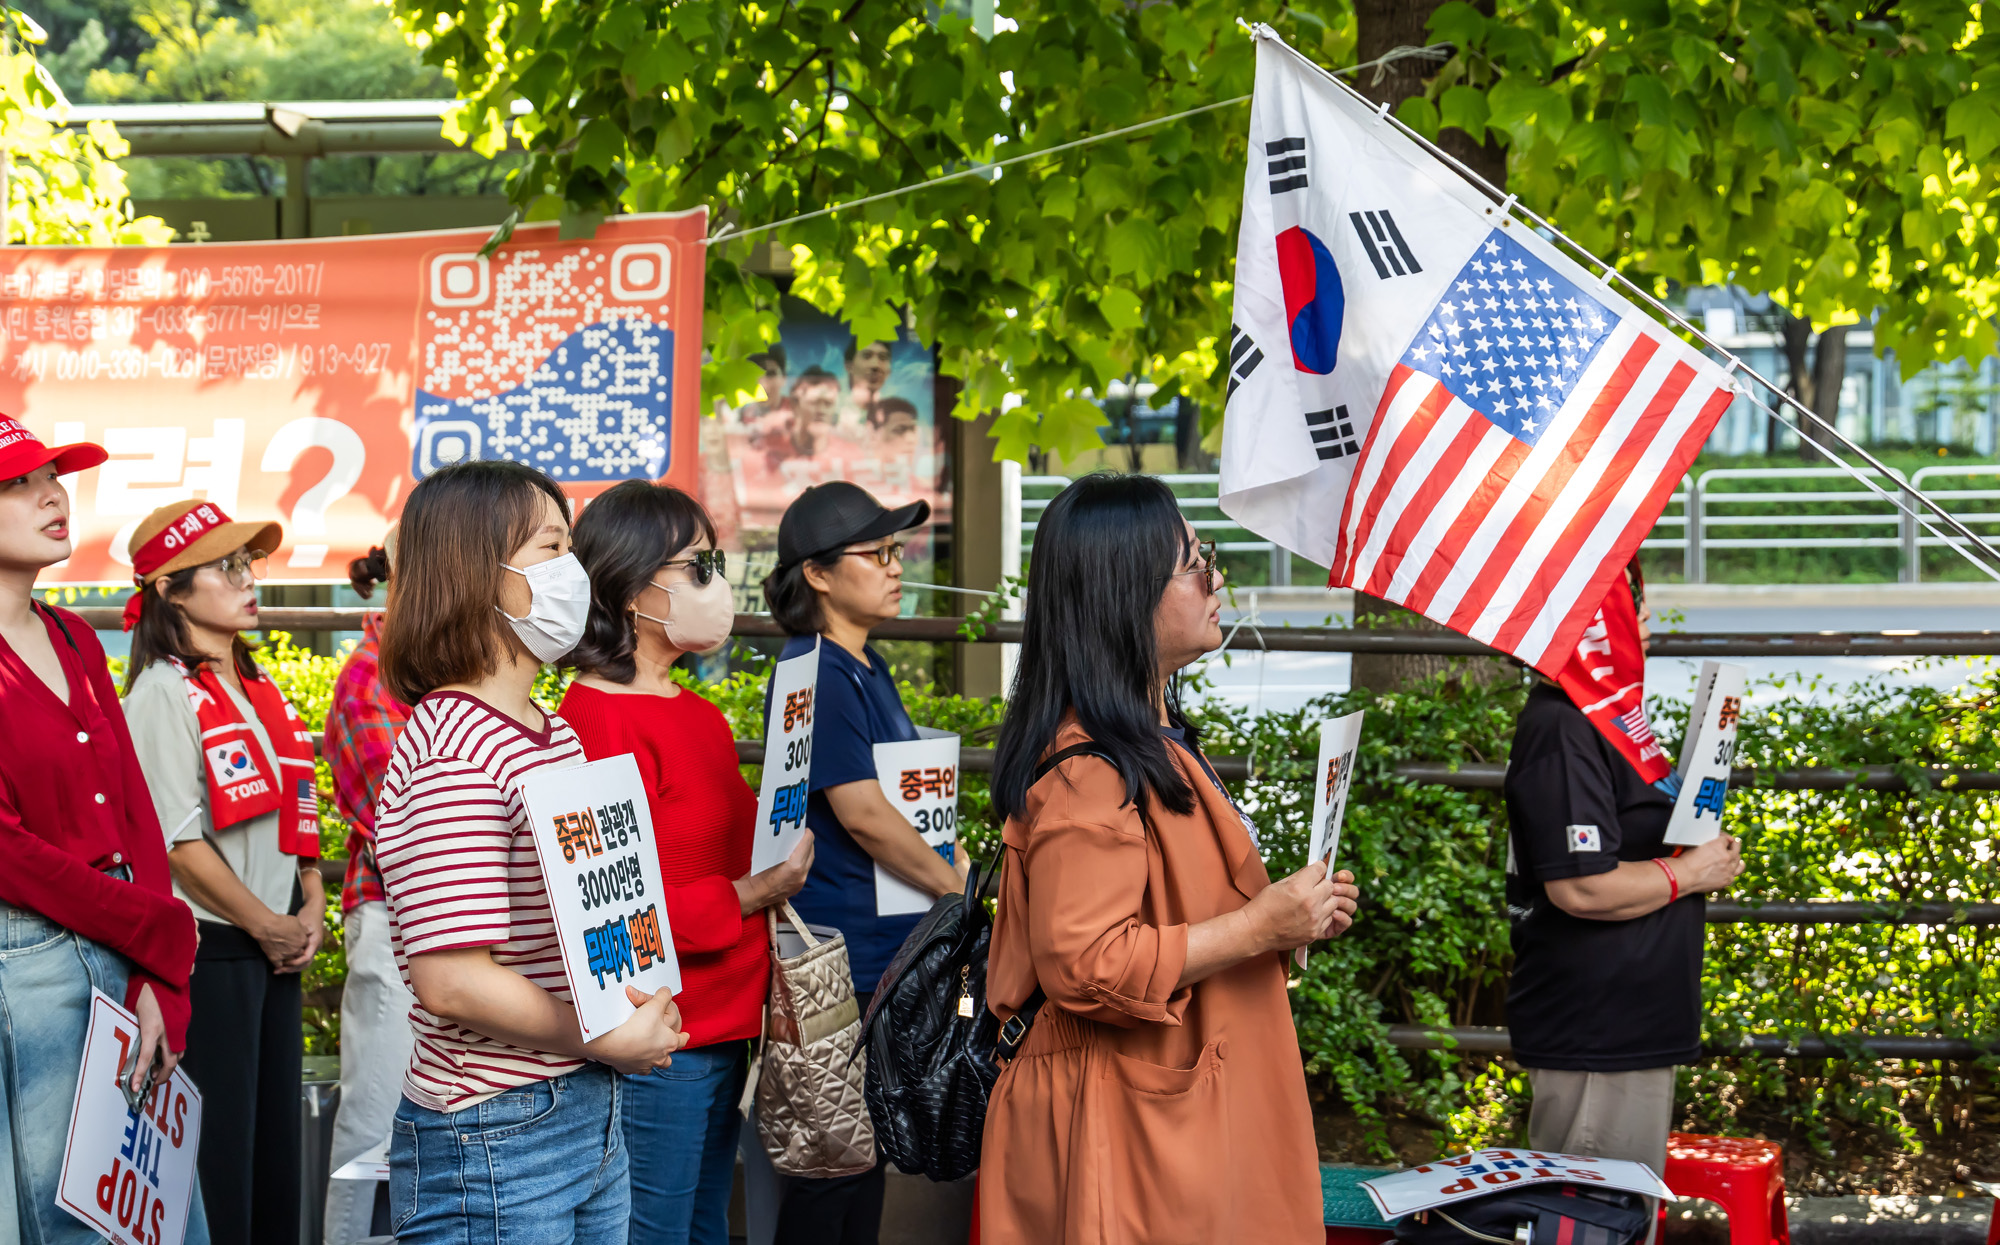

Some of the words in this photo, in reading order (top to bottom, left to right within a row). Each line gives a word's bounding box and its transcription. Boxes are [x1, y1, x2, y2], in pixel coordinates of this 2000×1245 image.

[301, 343, 392, 376] 9.13~9.27
[224, 779, 269, 803] YOON
[899, 764, 956, 802] 중국인
[552, 806, 604, 864] 중국인
[596, 798, 642, 851] 관광객
[577, 851, 646, 912] 3000만명
[583, 914, 636, 991] 무비자
[628, 903, 666, 972] 반대
[120, 1105, 162, 1189] THE
[1461, 1158, 1568, 1177] THE
[96, 1157, 165, 1245] STOP
[1440, 1168, 1606, 1194] STOP
